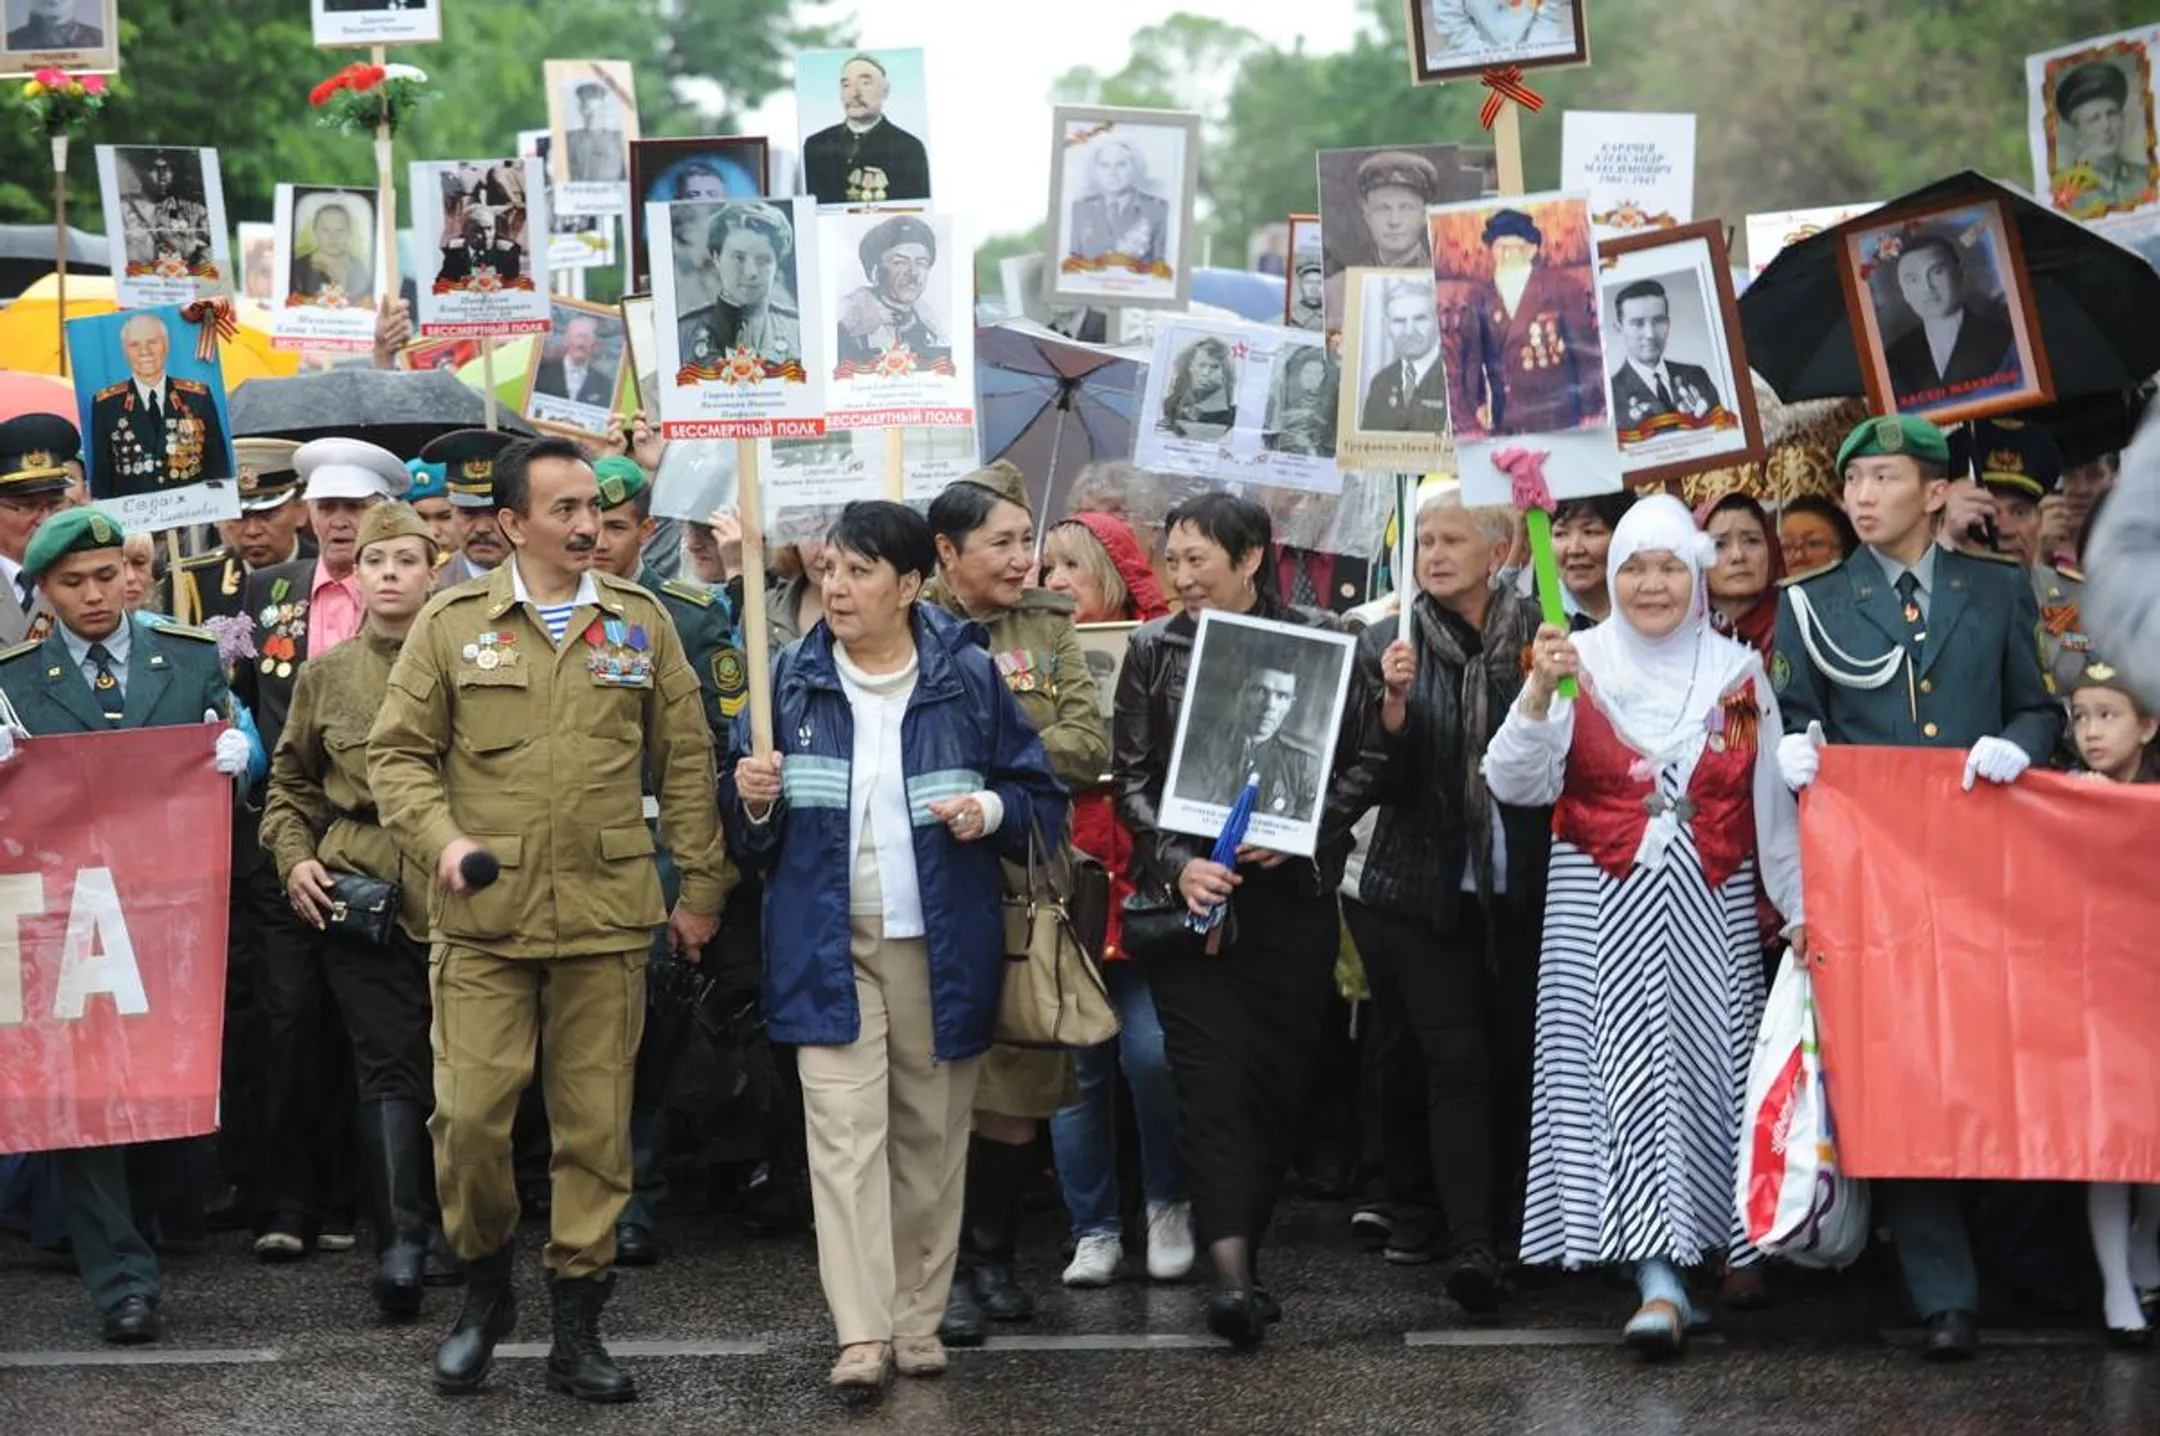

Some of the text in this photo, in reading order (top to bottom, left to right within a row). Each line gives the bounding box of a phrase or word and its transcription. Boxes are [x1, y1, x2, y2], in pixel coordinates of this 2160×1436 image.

[512, 321, 543, 334] ПОЛК
[925, 410, 964, 424] ПОЛК
[670, 421, 817, 438] БЕССМЕРТНЫЙ ПОЛК
